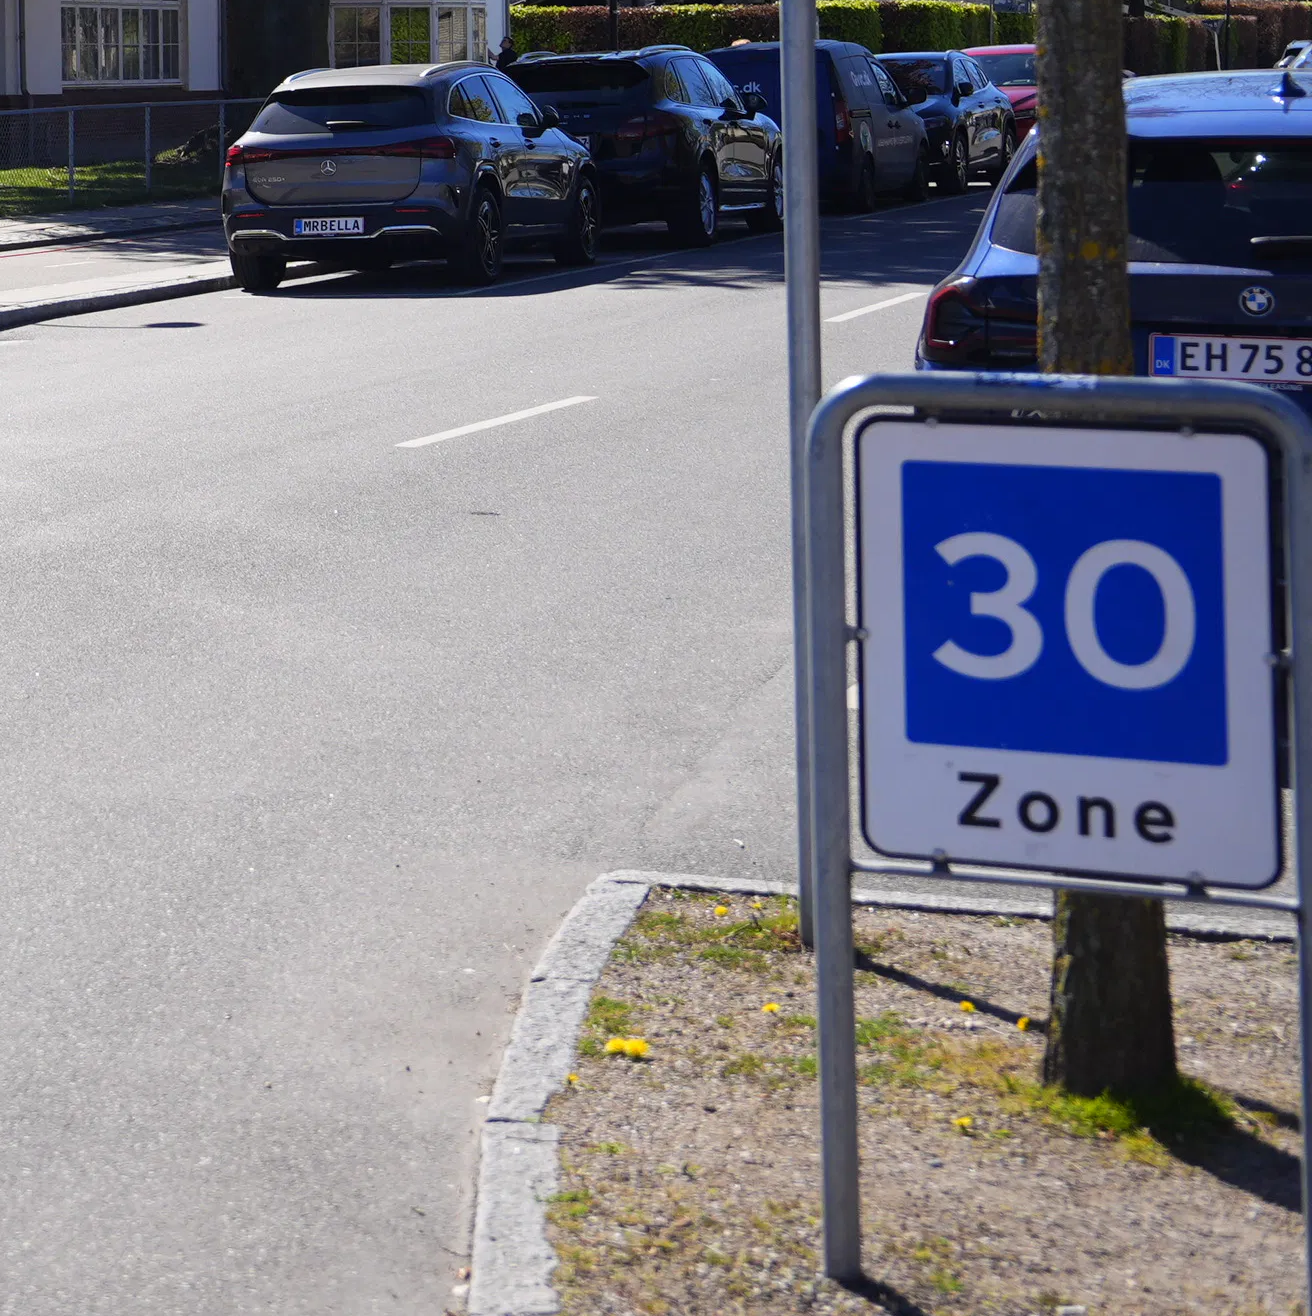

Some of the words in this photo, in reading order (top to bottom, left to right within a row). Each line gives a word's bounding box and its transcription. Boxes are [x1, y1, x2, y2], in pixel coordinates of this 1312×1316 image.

[303, 220, 360, 233] MRBELLA
[1156, 359, 1170, 369] DK
[1180, 342, 1227, 372] EH
[1239, 343, 1284, 374] 75
[931, 531, 1196, 691] 30
[957, 771, 1176, 844] Zone
